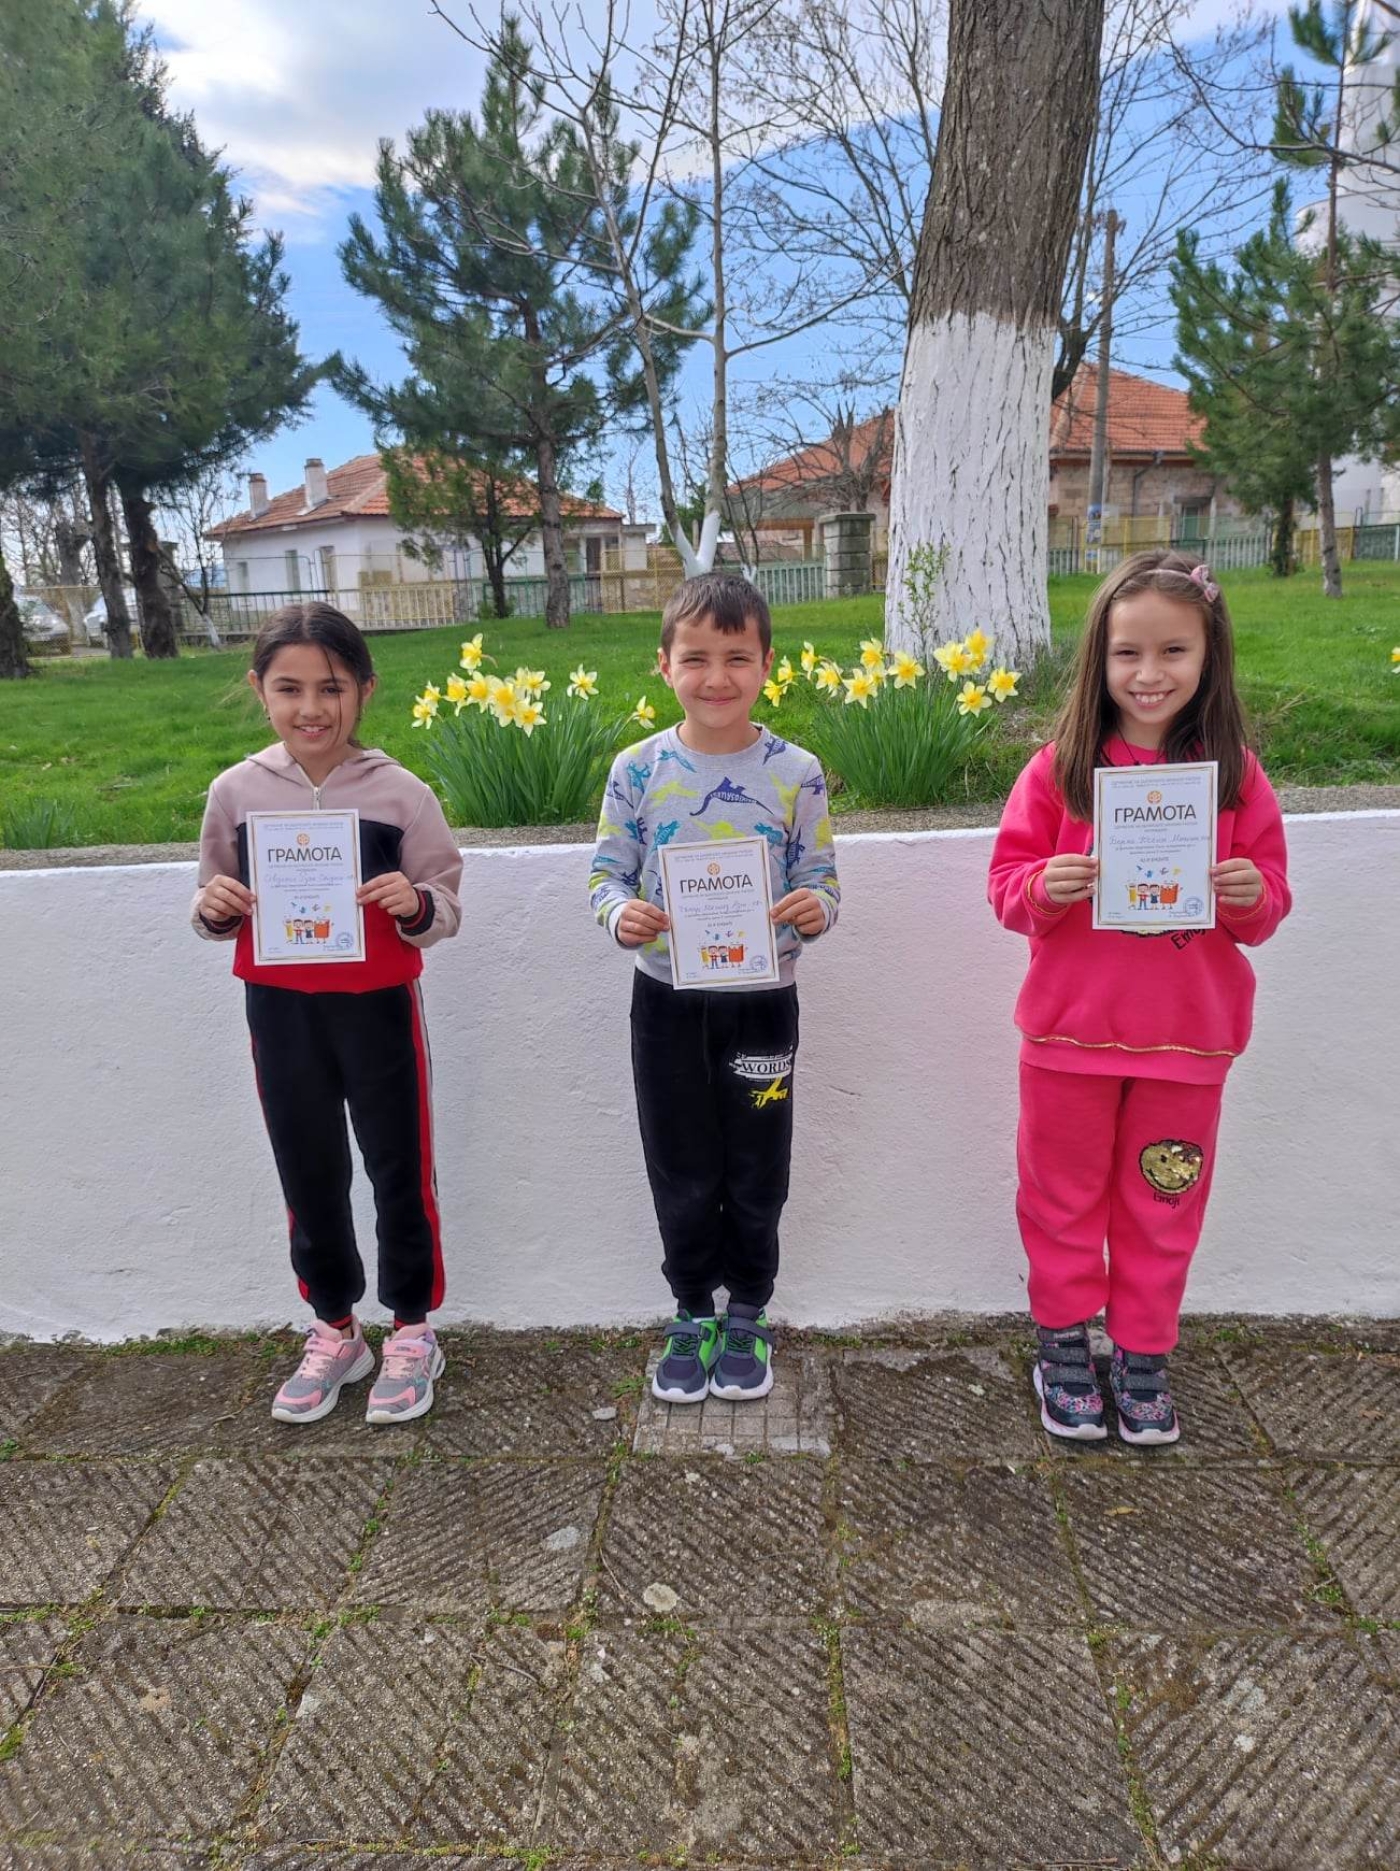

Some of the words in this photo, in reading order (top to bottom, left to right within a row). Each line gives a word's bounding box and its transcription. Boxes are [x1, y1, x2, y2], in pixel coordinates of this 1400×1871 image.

[1114, 804, 1197, 823] ГРАМОТА
[267, 846, 343, 863] ГРАМОТА
[680, 874, 753, 893] ГРАМОТА
[741, 1060, 791, 1073] WORDS
